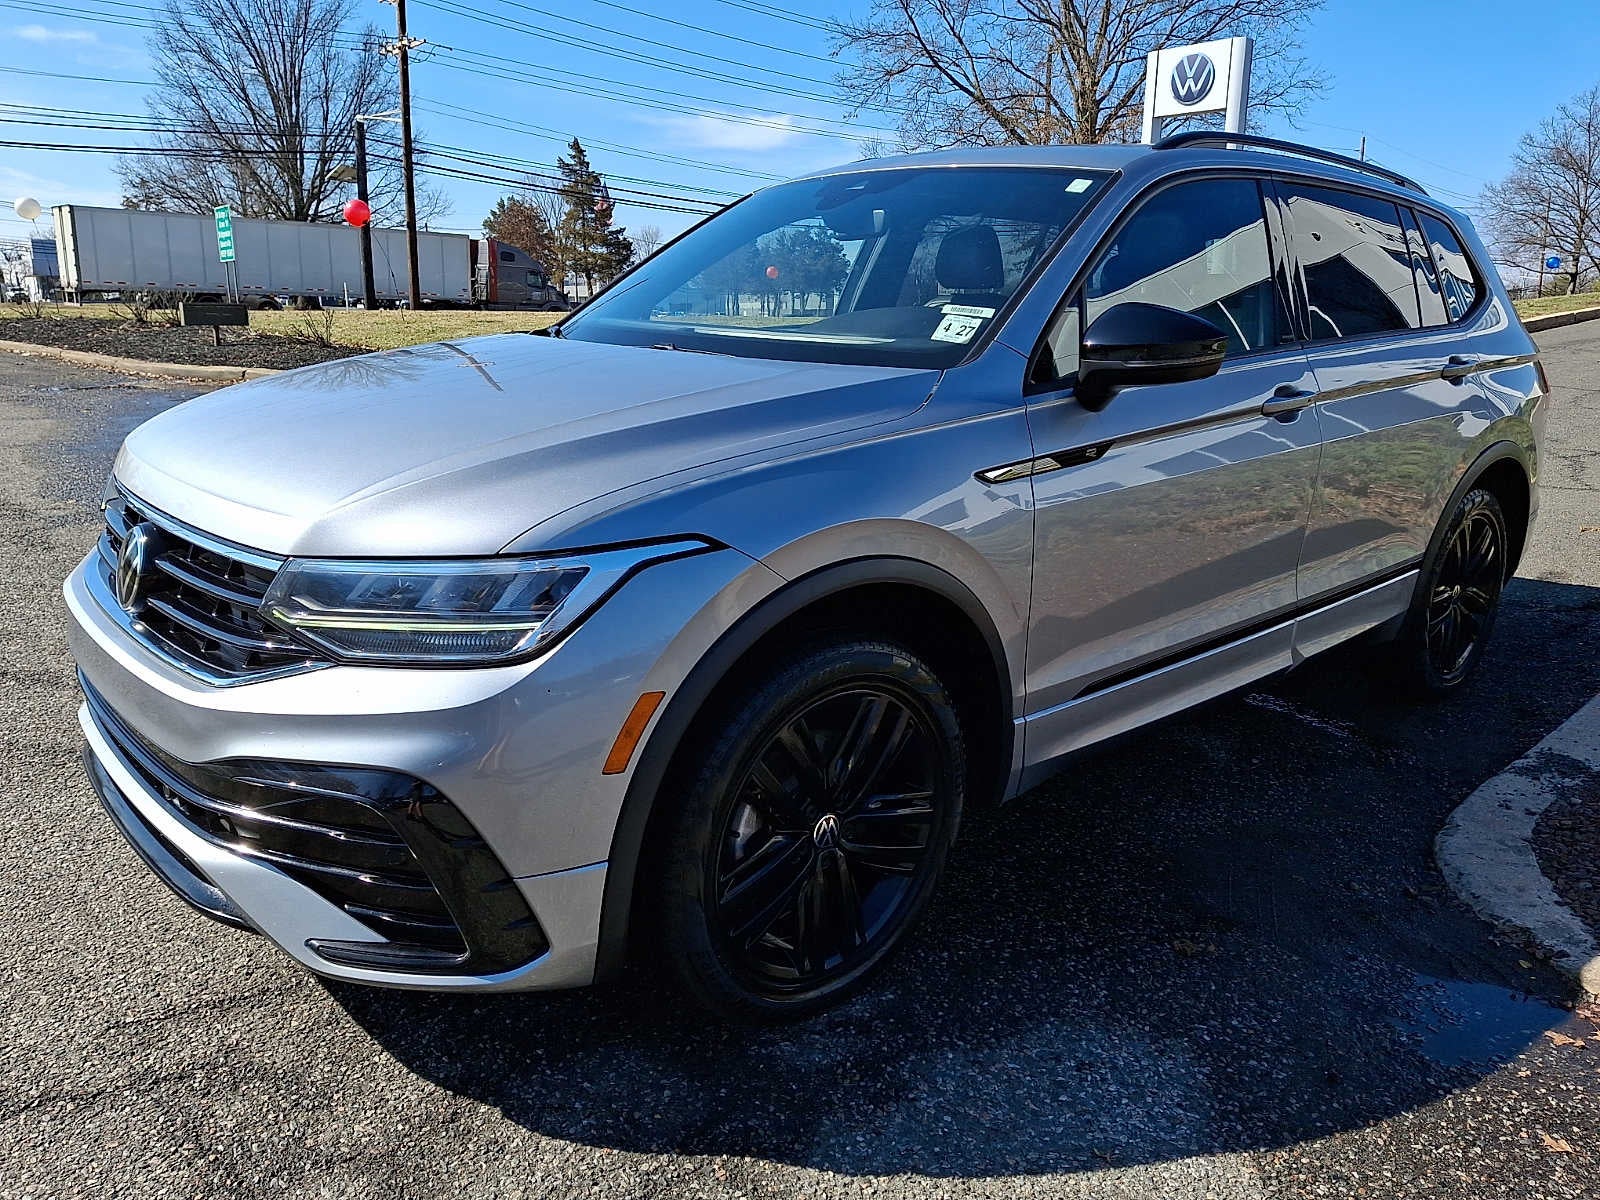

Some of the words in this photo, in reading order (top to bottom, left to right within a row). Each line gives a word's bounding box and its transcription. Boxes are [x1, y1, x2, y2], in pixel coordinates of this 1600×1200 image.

[1172, 52, 1214, 104] VW
[943, 322, 953, 333] 4
[955, 324, 977, 337] 27
